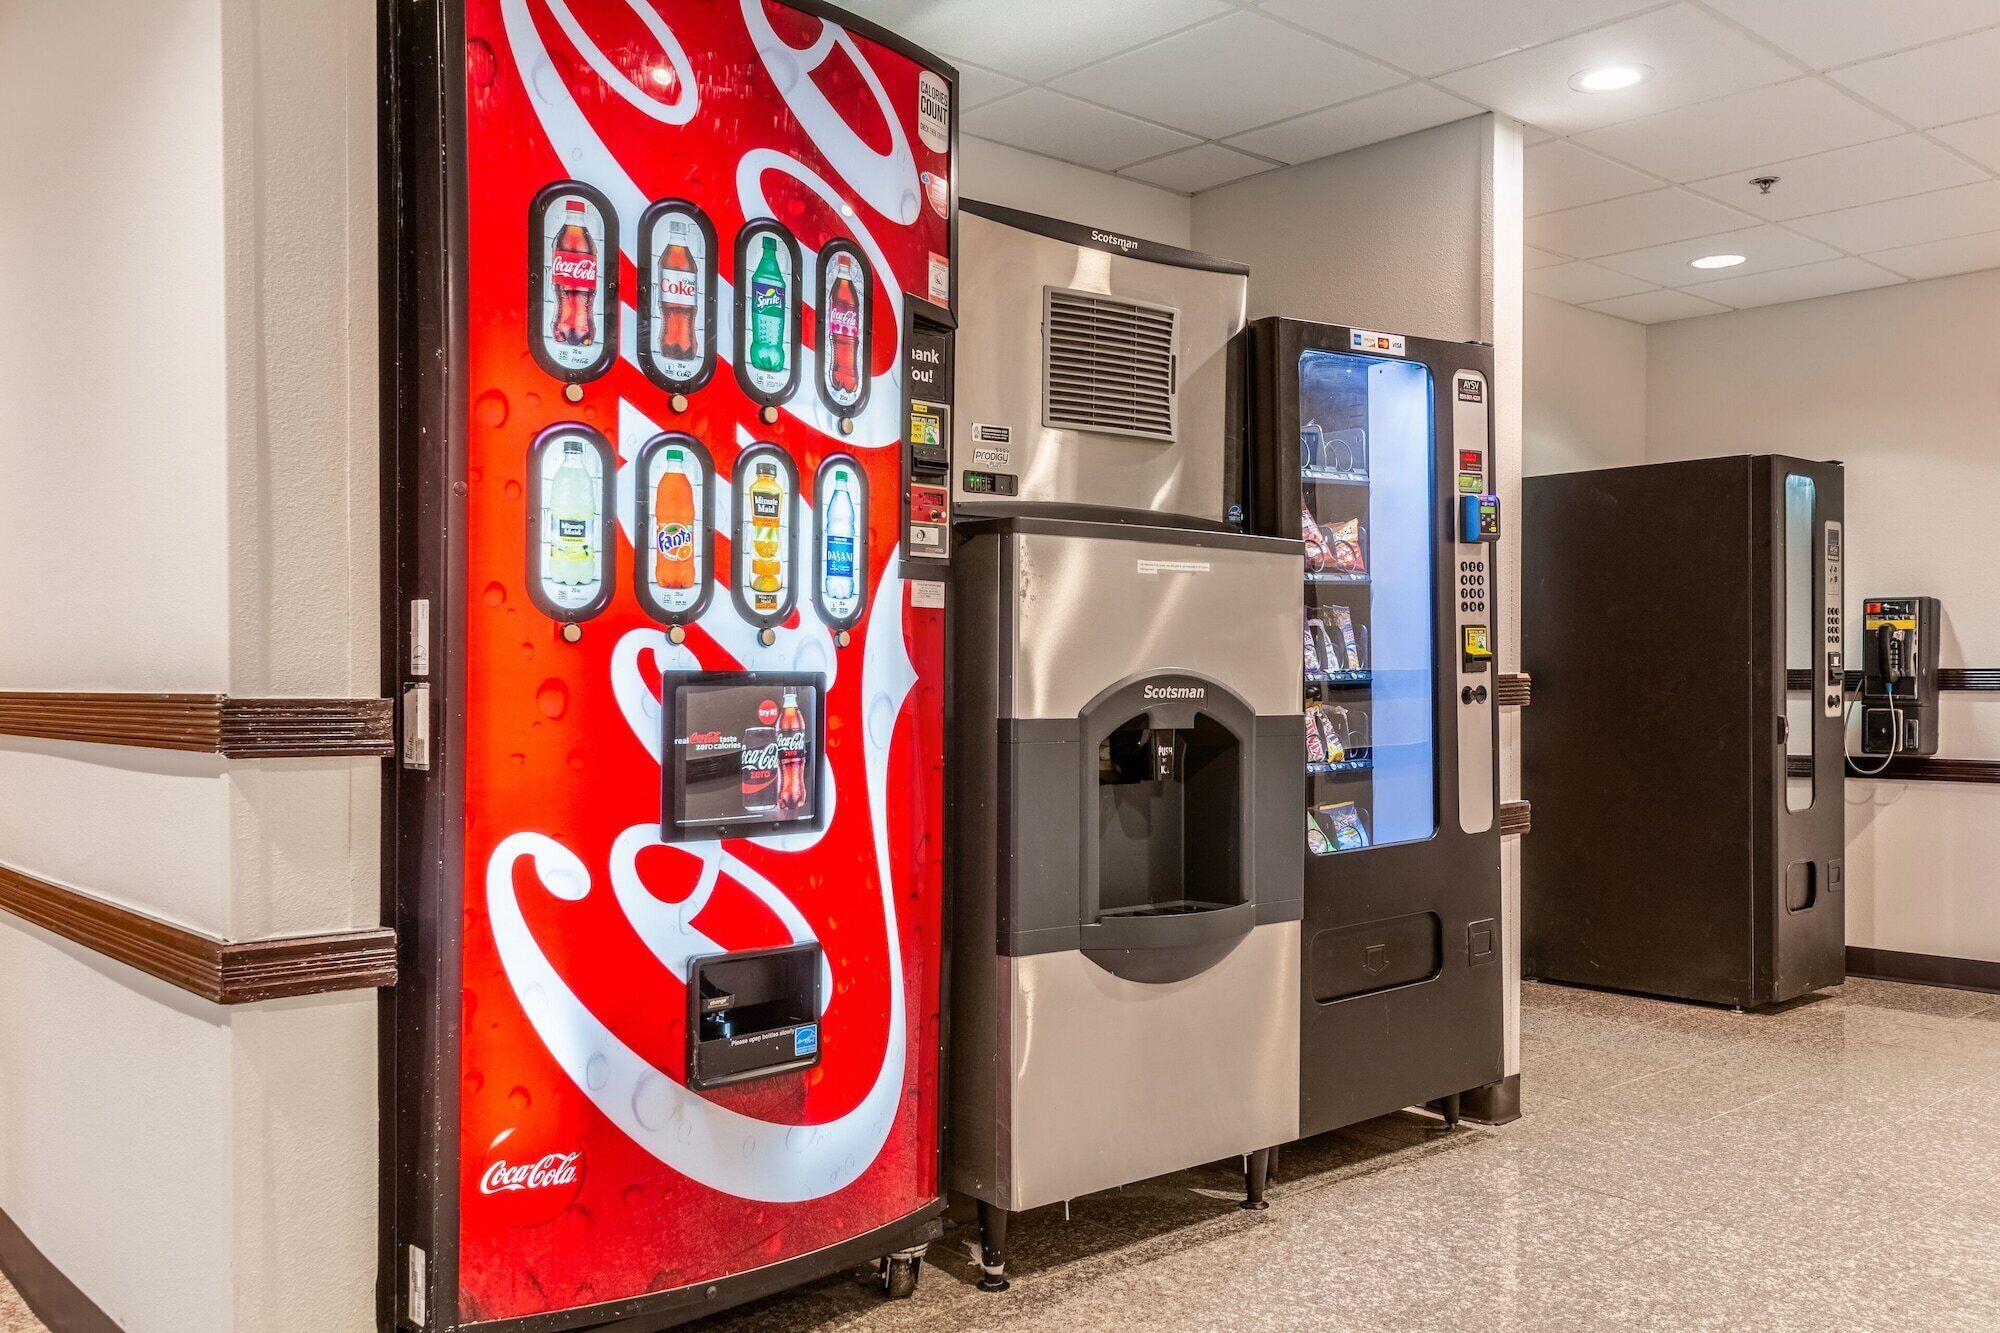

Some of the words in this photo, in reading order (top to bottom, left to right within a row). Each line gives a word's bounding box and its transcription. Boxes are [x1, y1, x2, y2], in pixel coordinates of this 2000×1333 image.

[920, 81, 948, 107] CALORIES
[920, 96, 948, 125] COUNT
[1091, 230, 1138, 252] Scotsman
[553, 256, 596, 280] Coca-Cola
[660, 278, 695, 296] Coke
[757, 294, 780, 308] Sprite
[831, 308, 857, 326] Coca-Cola
[911, 366, 934, 384] ou!
[1463, 380, 1480, 390] AYSV
[754, 495, 779, 506] Minute
[757, 504, 776, 514] Maid
[564, 528, 583, 536] Maid
[658, 529, 691, 553] Fanta
[828, 550, 853, 562] DASANI
[1143, 684, 1205, 699] Scotsman
[759, 708, 770, 717] try
[674, 736, 690, 745] real
[719, 735, 738, 743] taste
[695, 743, 714, 751] zero
[713, 742, 742, 750] calories
[750, 770, 771, 779] zero
[709, 998, 727, 1006] change
[731, 1038, 748, 1047] Please
[748, 1035, 762, 1044] open
[761, 1031, 779, 1040] bottles
[779, 1028, 795, 1037] slowly
[480, 1151, 582, 1195] Coca-Cola
